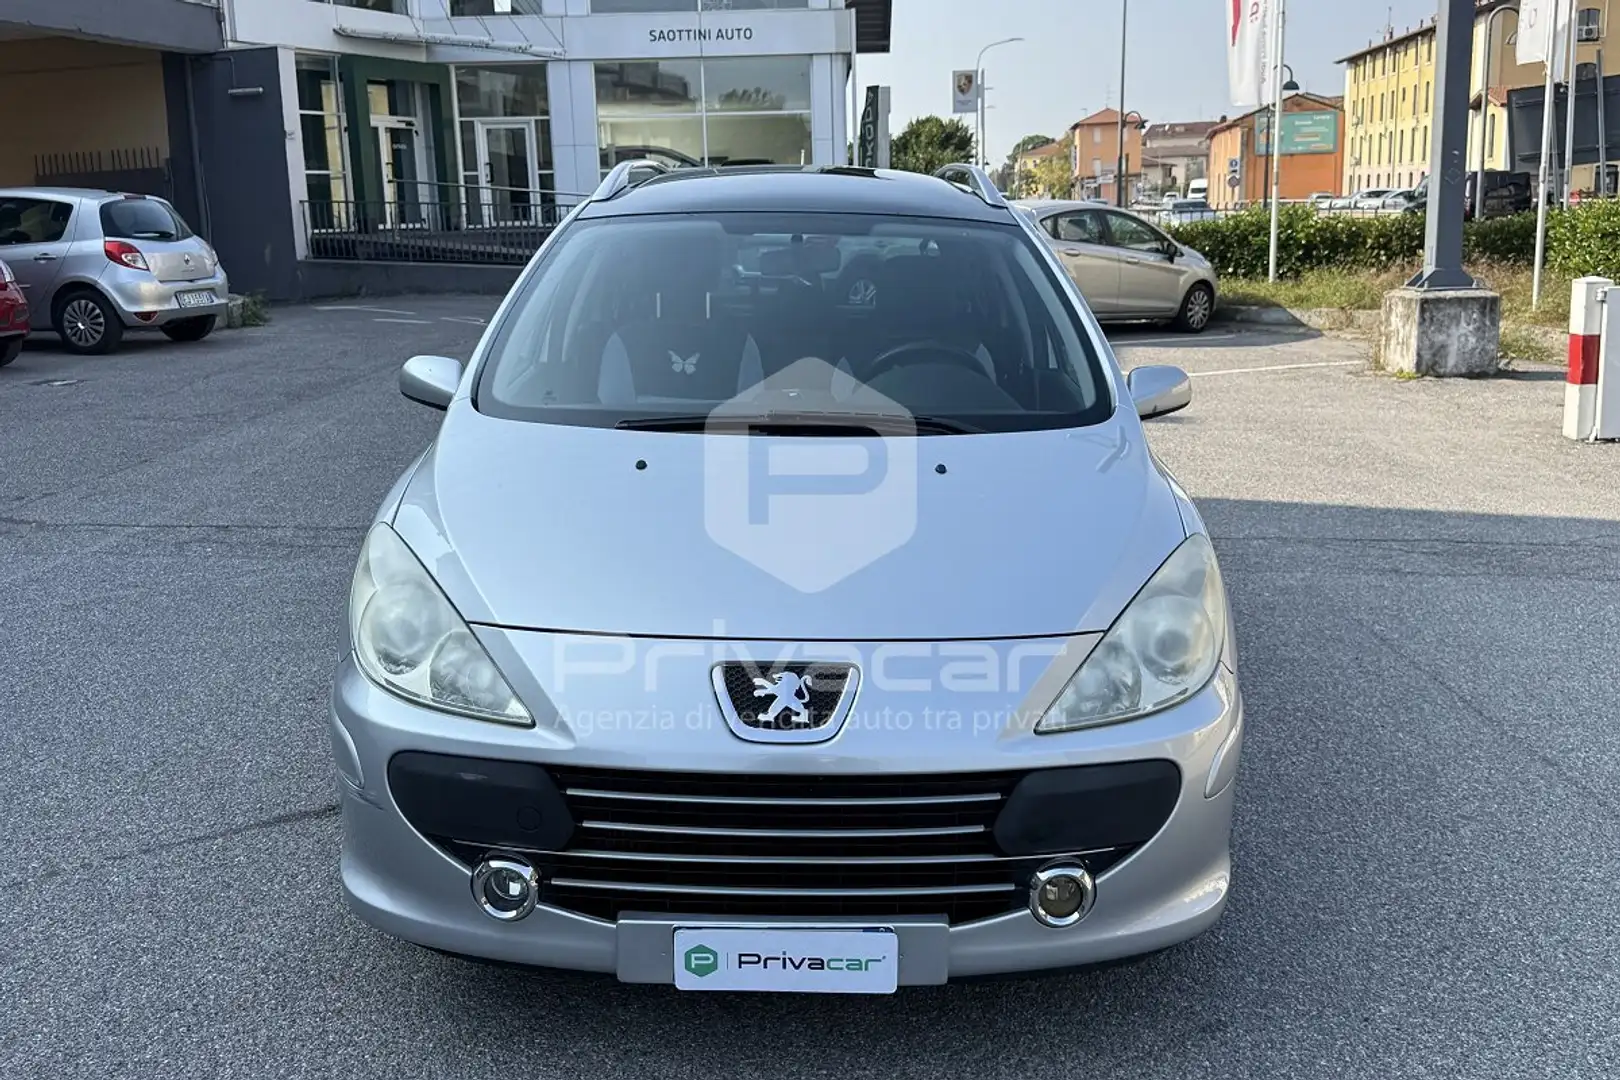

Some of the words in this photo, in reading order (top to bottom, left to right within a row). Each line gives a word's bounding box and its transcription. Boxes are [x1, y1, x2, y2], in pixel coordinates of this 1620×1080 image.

[649, 28, 711, 42] SAOTTINI
[716, 27, 753, 41] AUTO
[690, 953, 714, 969] P
[738, 950, 885, 972] Privacar
